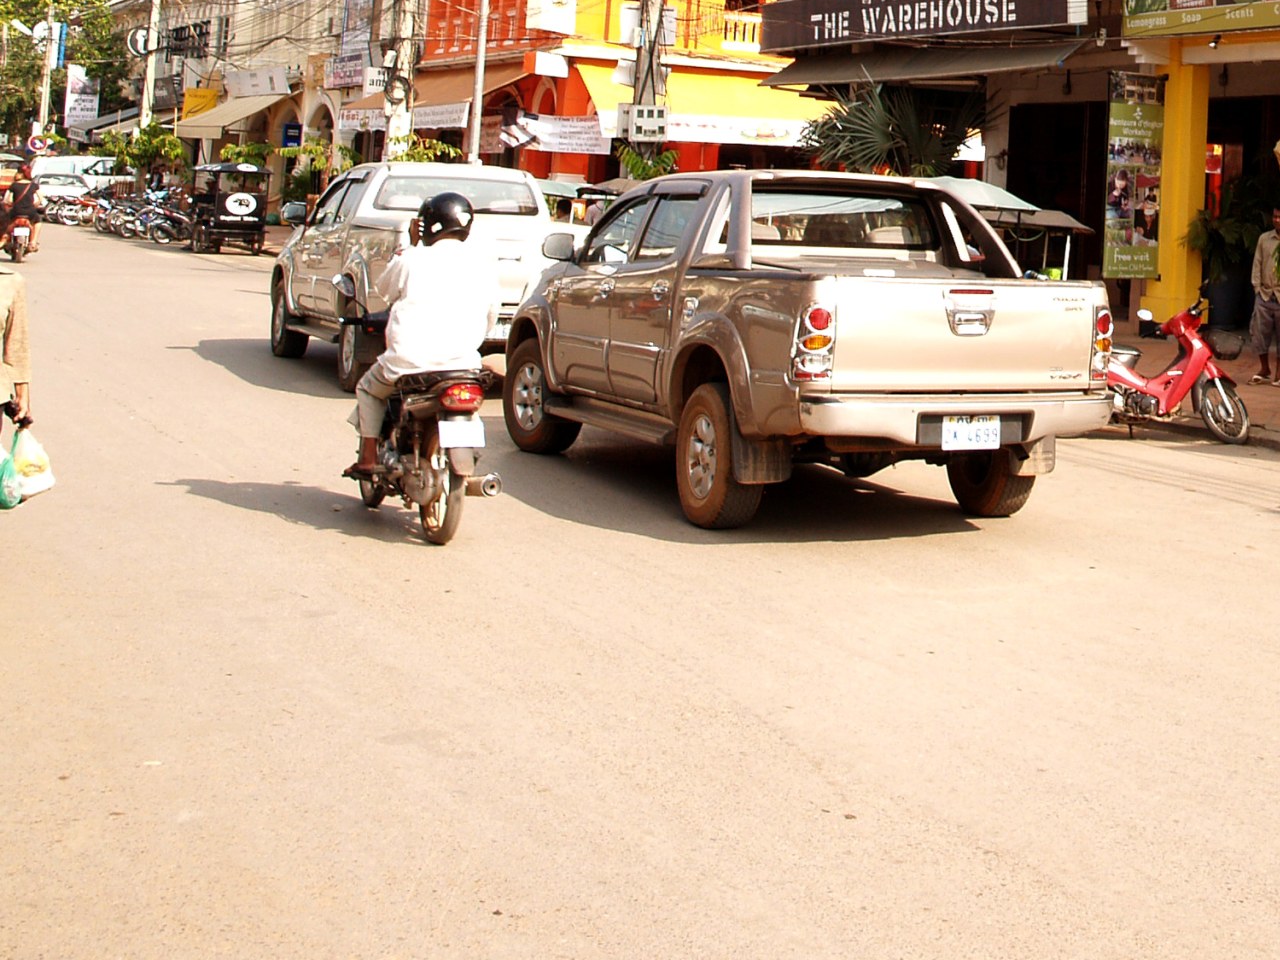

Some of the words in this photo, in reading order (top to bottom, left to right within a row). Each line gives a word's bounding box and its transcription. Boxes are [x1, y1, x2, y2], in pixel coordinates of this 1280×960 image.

[1182, 13, 1201, 24] Soap
[1225, 8, 1254, 19] Scents
[811, 11, 849, 39] THE
[1127, 16, 1167, 28] Lemongrass
[1114, 248, 1131, 264] free
[1133, 252, 1149, 262] visit
